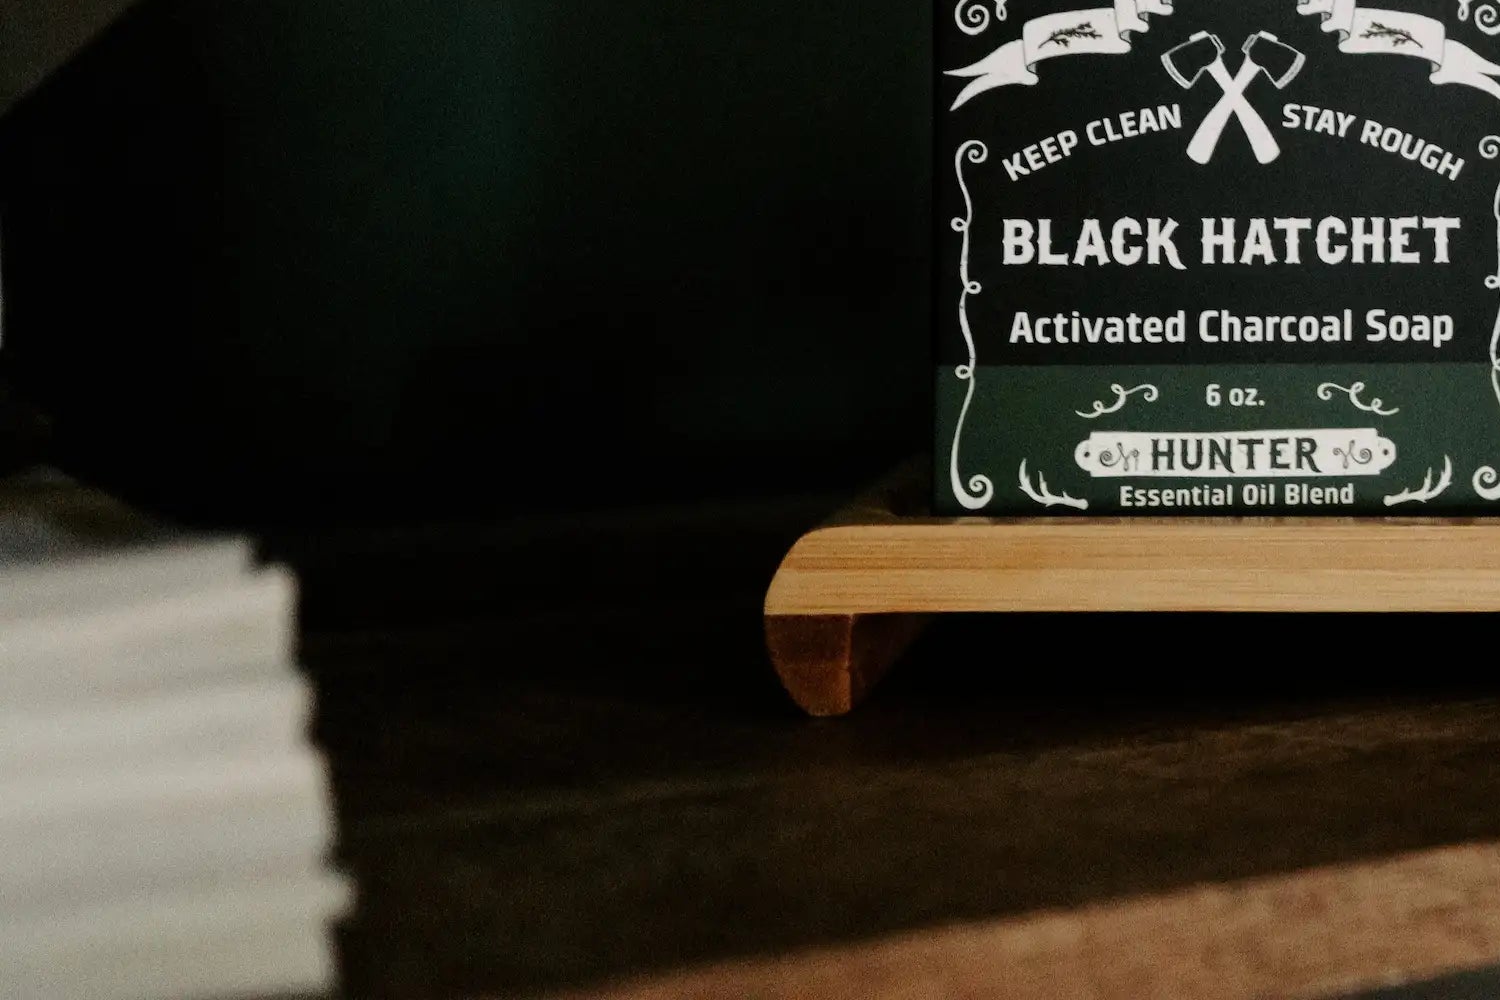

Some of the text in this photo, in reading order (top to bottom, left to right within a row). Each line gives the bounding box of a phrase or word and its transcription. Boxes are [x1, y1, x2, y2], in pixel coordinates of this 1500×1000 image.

[1001, 103, 1465, 182] KEEP CLEAN STAY ROUGH
[1001, 215, 1461, 270] BLACK HATCHET
[1009, 308, 1454, 348] Activated Charcoal Soap
[1205, 383, 1266, 407] 6 oz.
[1151, 437, 1322, 473] HUNTER
[1120, 482, 1354, 507] Essential Oil Blend
